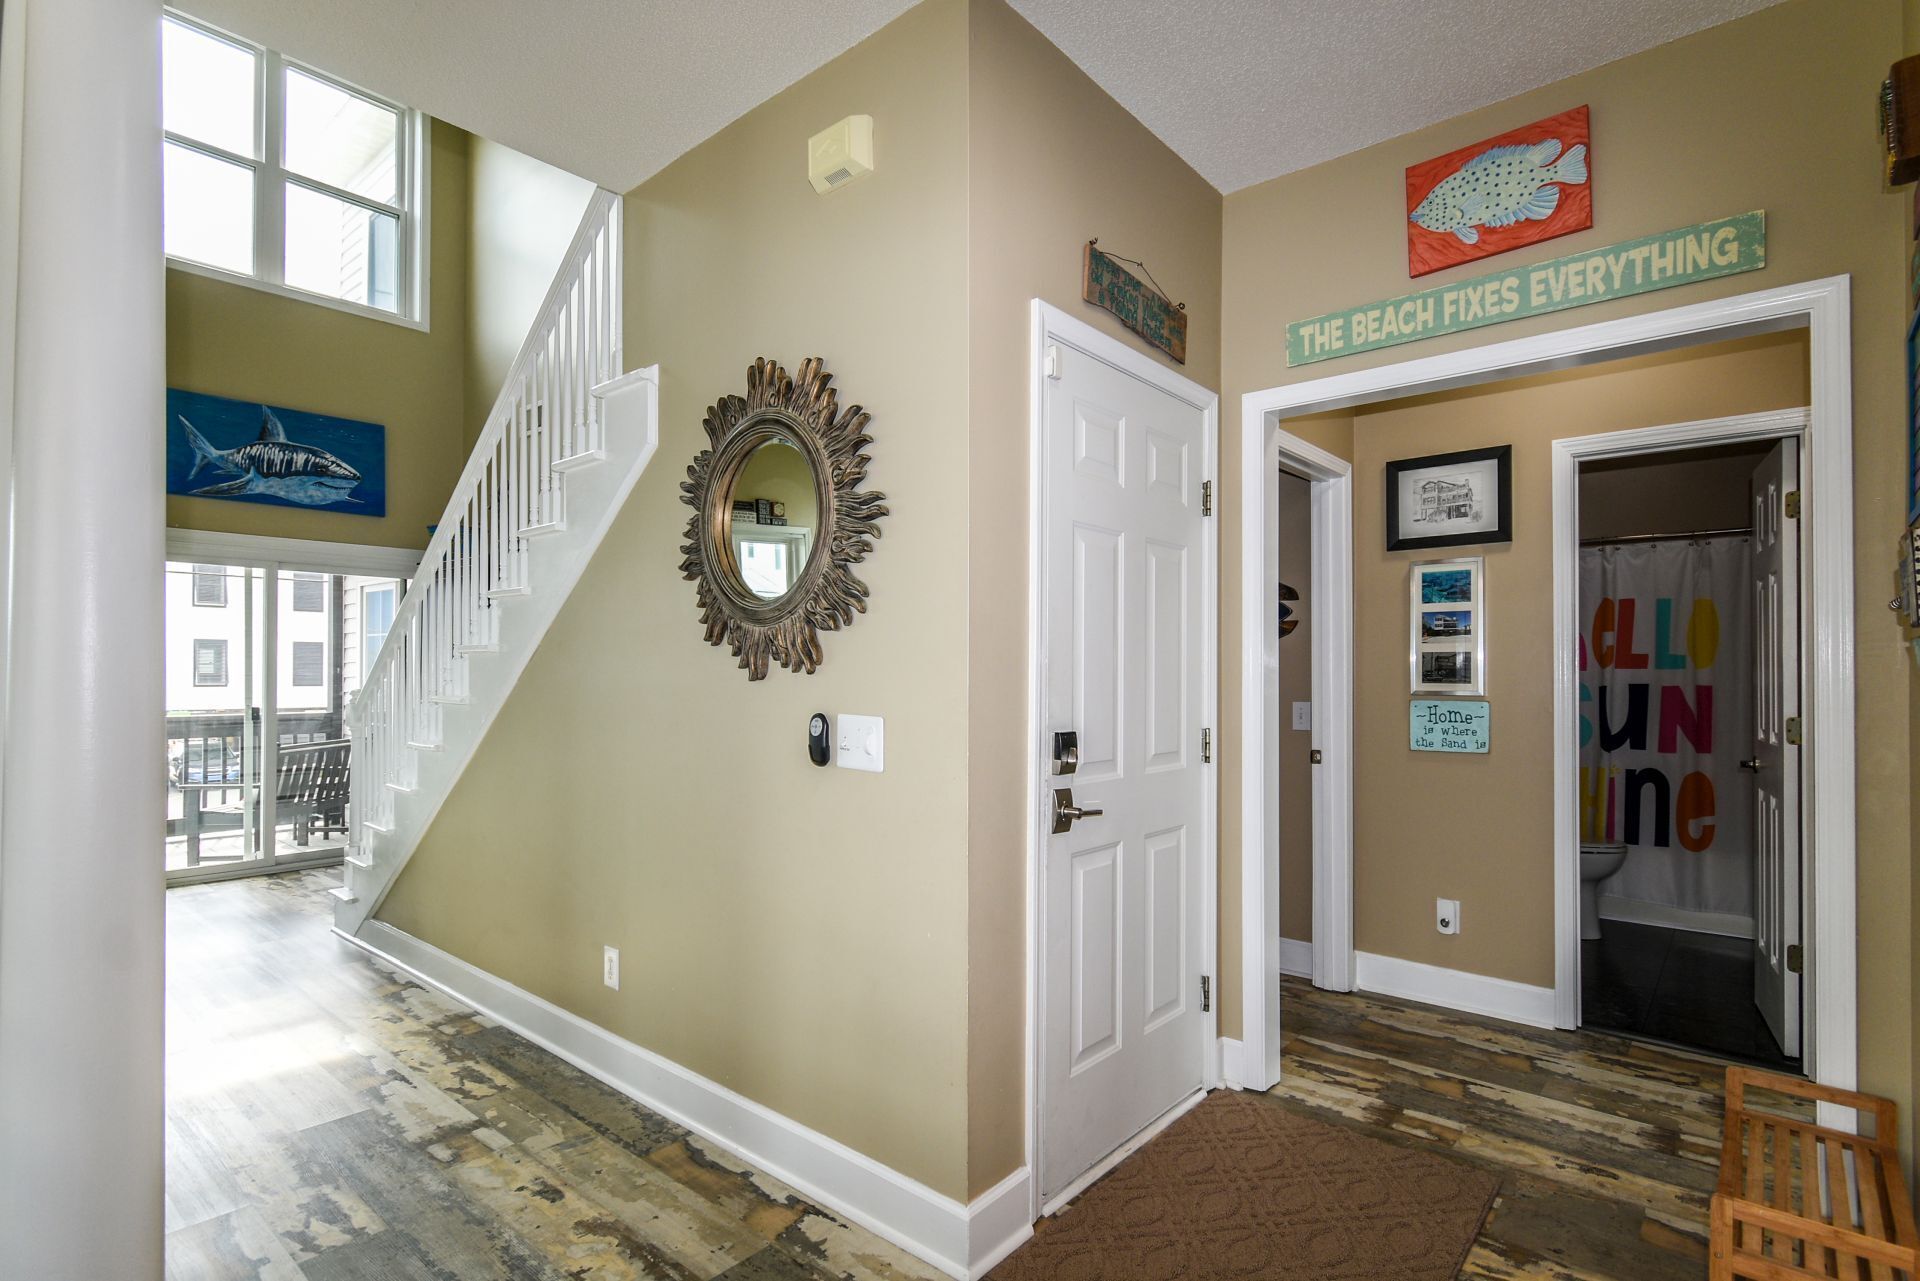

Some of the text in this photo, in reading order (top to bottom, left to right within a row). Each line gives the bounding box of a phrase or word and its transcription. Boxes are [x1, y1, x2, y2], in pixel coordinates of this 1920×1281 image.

[1299, 226, 1739, 356] THE BEACH FIXES EVERYTHING
[1427, 705, 1473, 725] Home
[1423, 725, 1478, 736] is where
[1415, 737, 1486, 750] the Sand is
